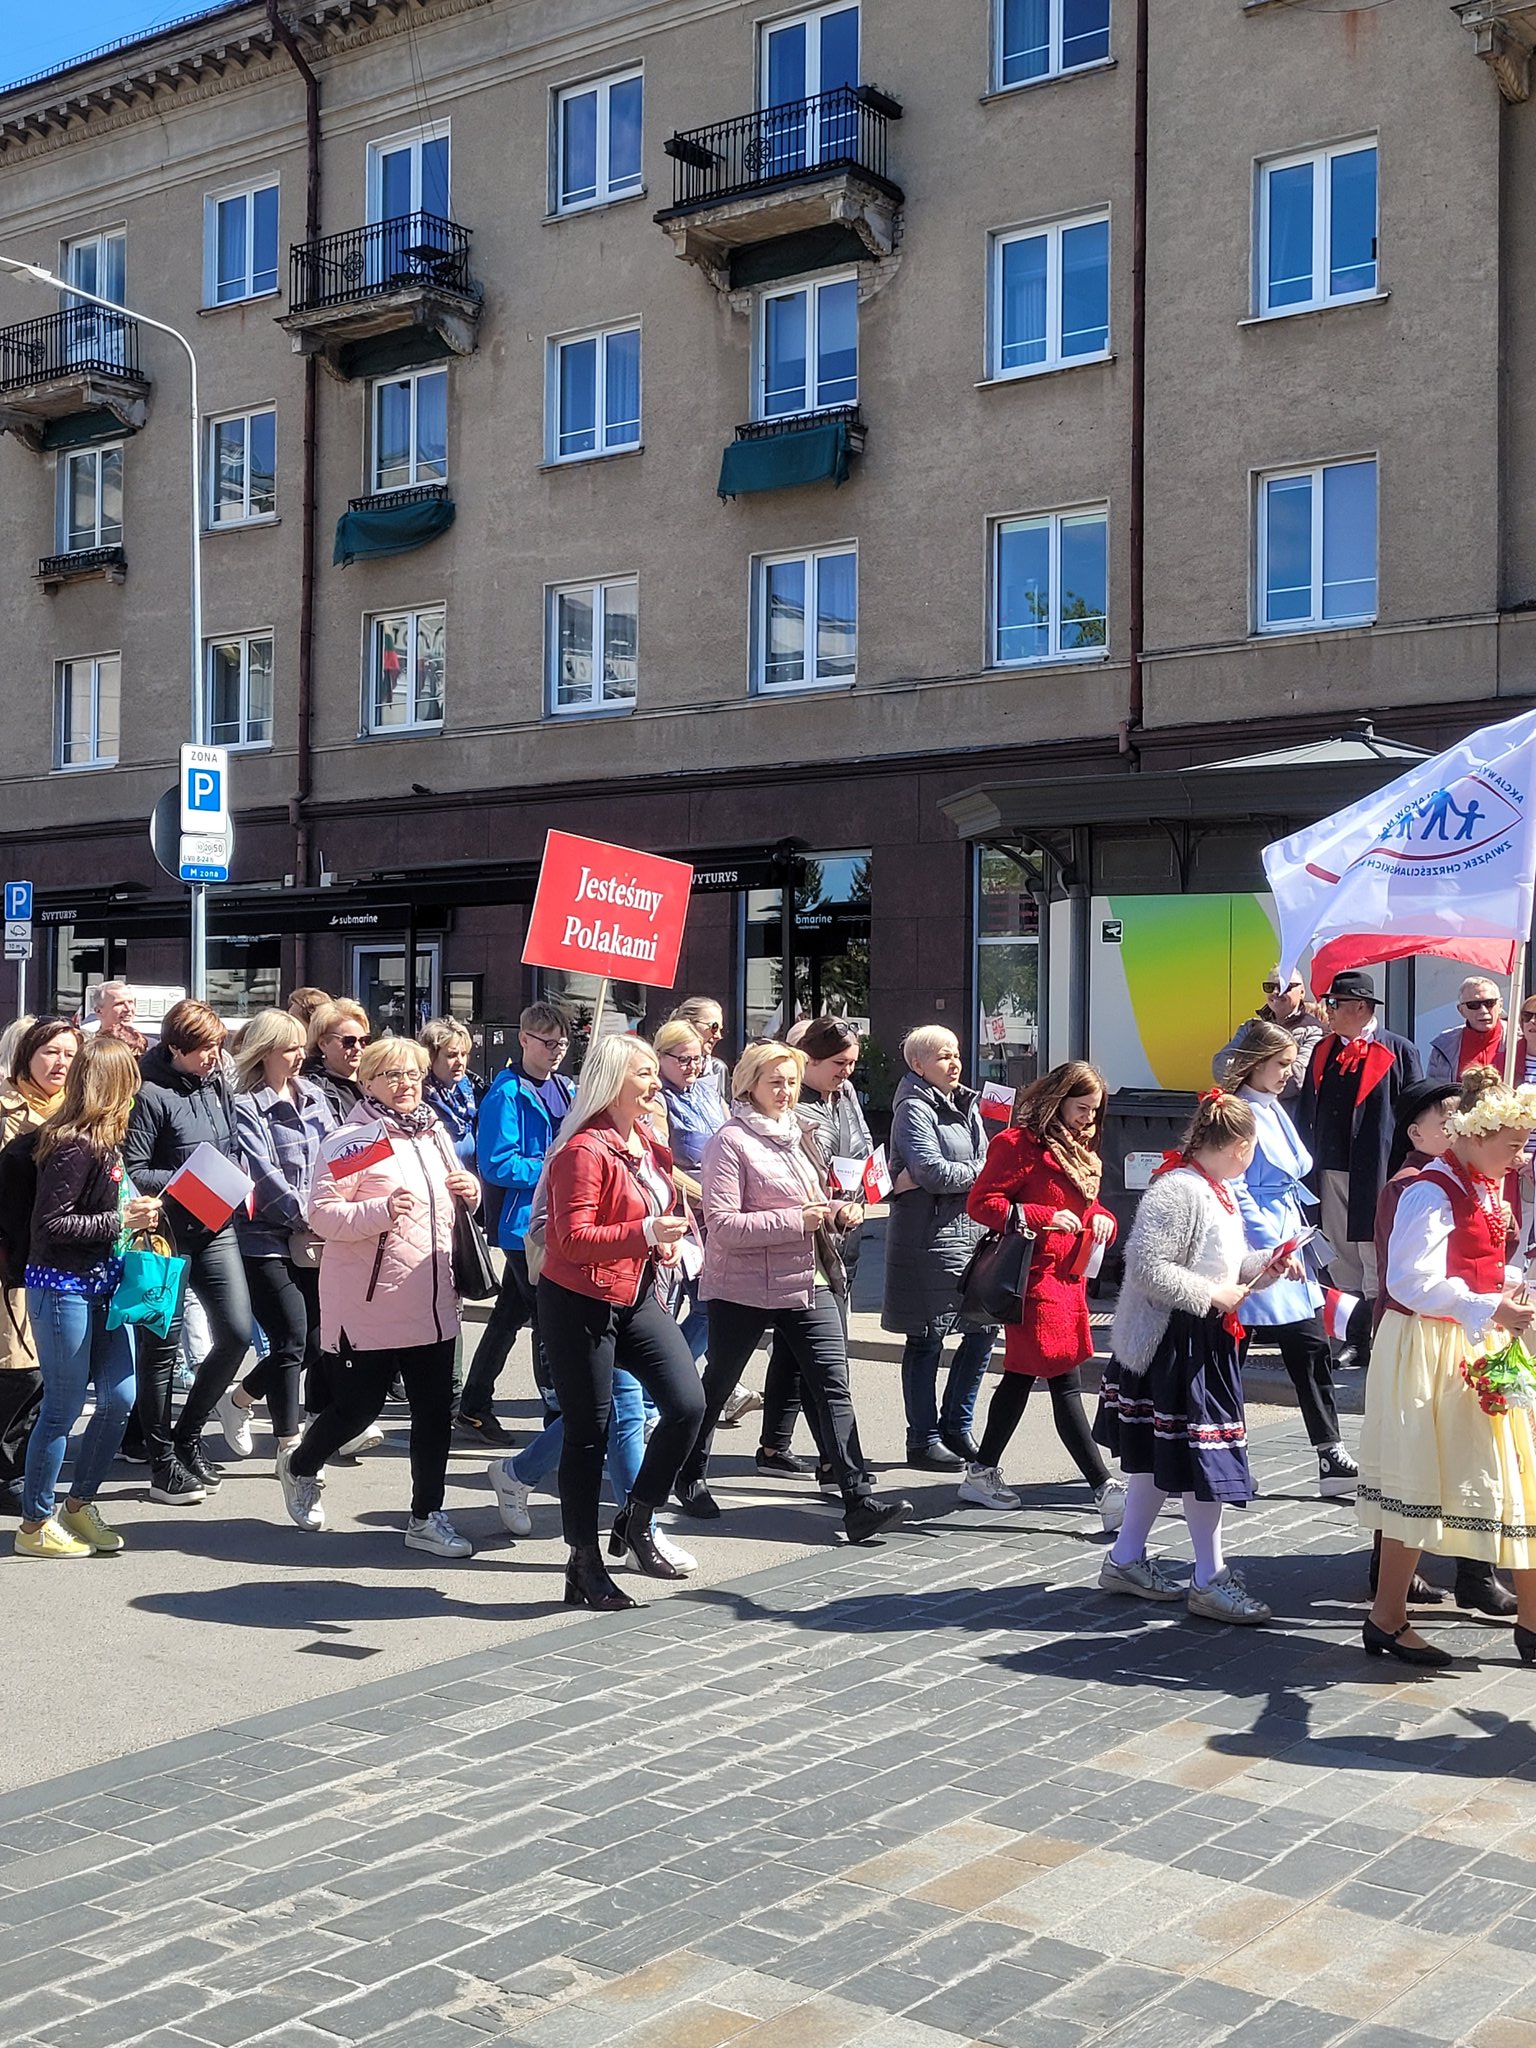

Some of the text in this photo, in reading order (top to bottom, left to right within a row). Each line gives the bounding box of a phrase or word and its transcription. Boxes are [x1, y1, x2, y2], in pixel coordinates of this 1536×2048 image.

[191, 751, 218, 763] ZONA
[194, 772, 214, 807] P
[213, 844, 223, 853] 50
[190, 868, 198, 877] M
[692, 871, 738, 884] VYTURYS
[574, 866, 664, 922] Jesteśmy
[12, 886, 27, 916] P
[339, 913, 378, 924] submarine
[795, 914, 833, 924] bmarine
[560, 915, 659, 962] Polakami
